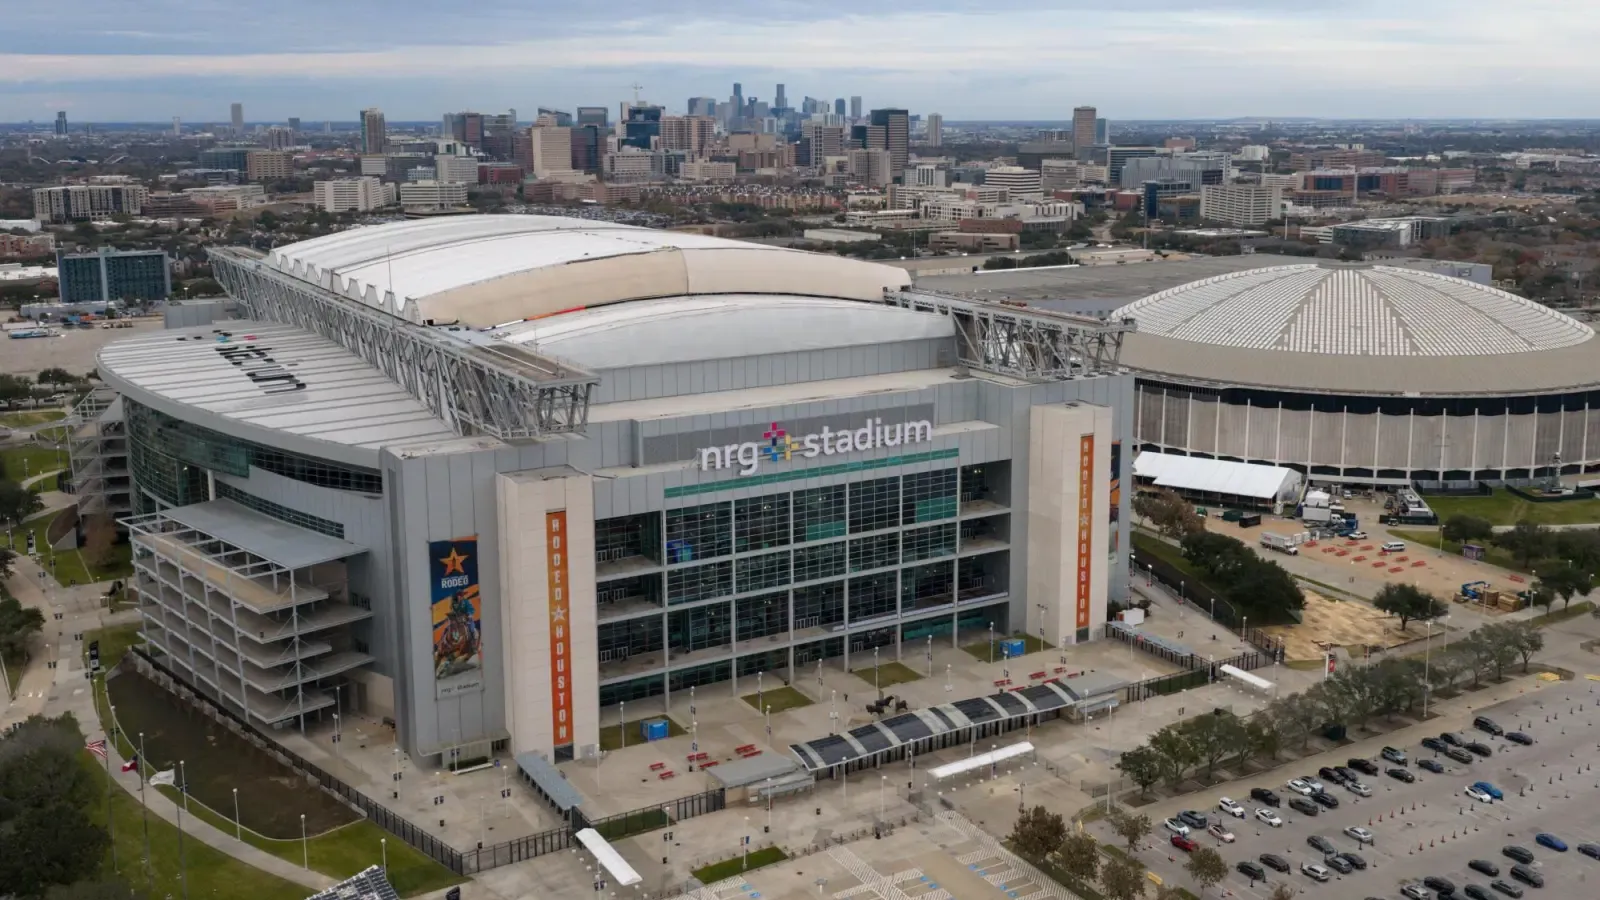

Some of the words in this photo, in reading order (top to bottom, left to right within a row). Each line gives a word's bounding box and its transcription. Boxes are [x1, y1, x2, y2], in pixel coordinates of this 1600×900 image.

[701, 441, 759, 476] nrg
[803, 417, 933, 458] stadium
[1081, 440, 1089, 509] RODEO
[441, 577, 469, 589] RODEO
[551, 518, 563, 602] RODEO
[1078, 529, 1088, 623] HOUSTON
[555, 624, 567, 740] HOUSTON
